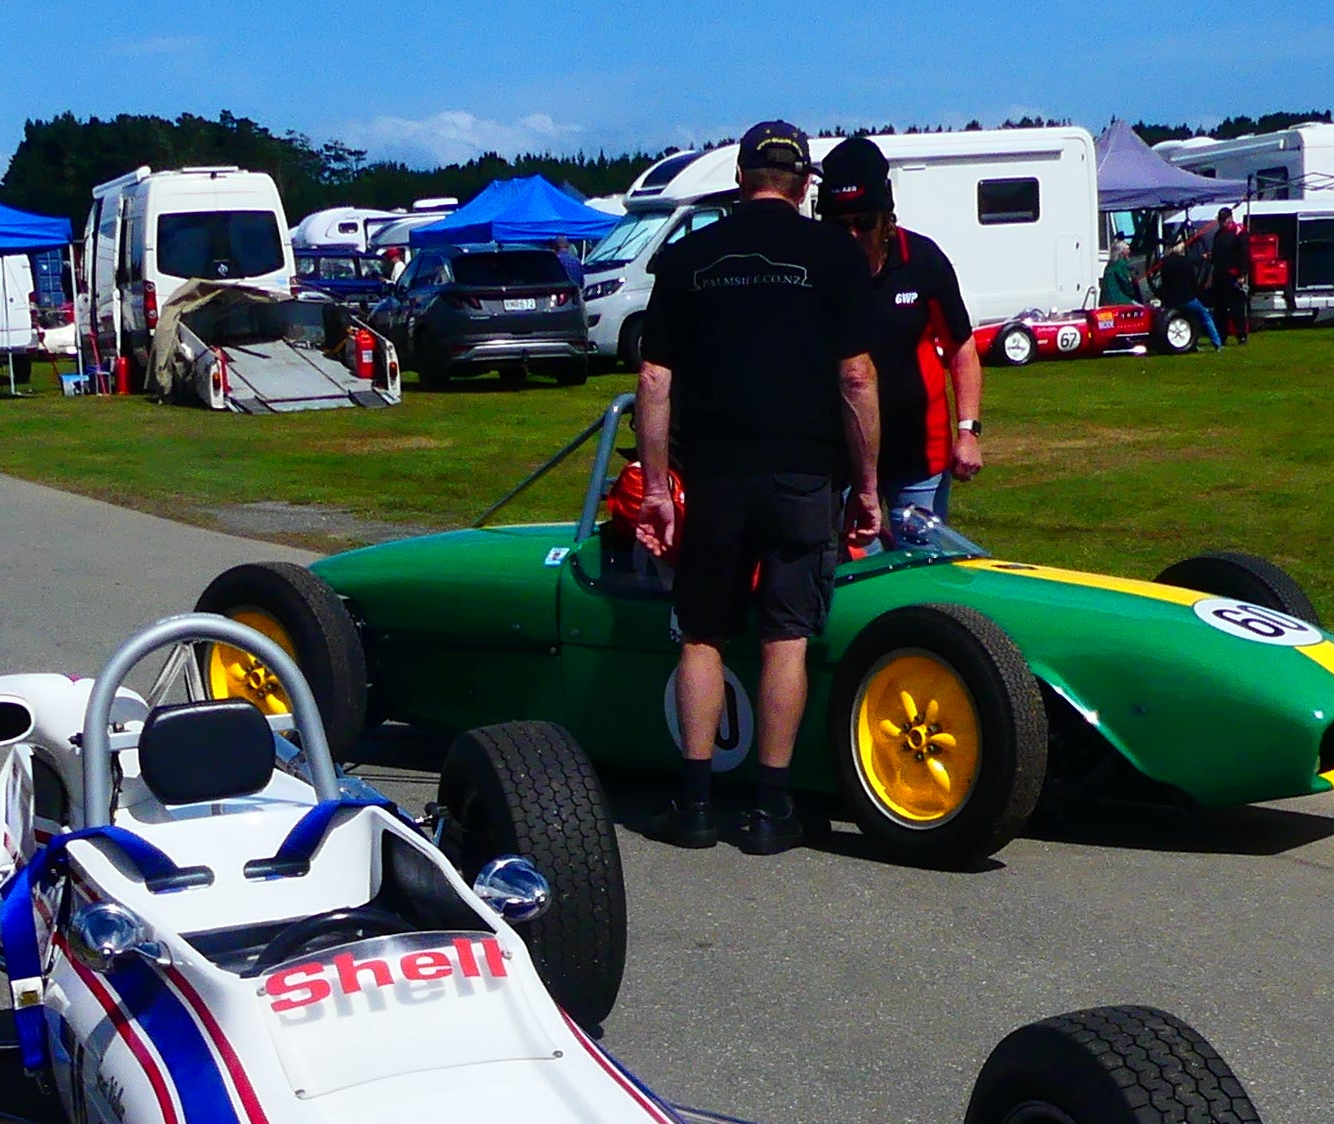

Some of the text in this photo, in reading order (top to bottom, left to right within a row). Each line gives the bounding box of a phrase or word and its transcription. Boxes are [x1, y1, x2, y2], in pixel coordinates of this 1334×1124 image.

[895, 291, 918, 304] GWP
[1060, 332, 1077, 348] 67
[1211, 604, 1309, 638] 60
[264, 937, 508, 1014] Shell
